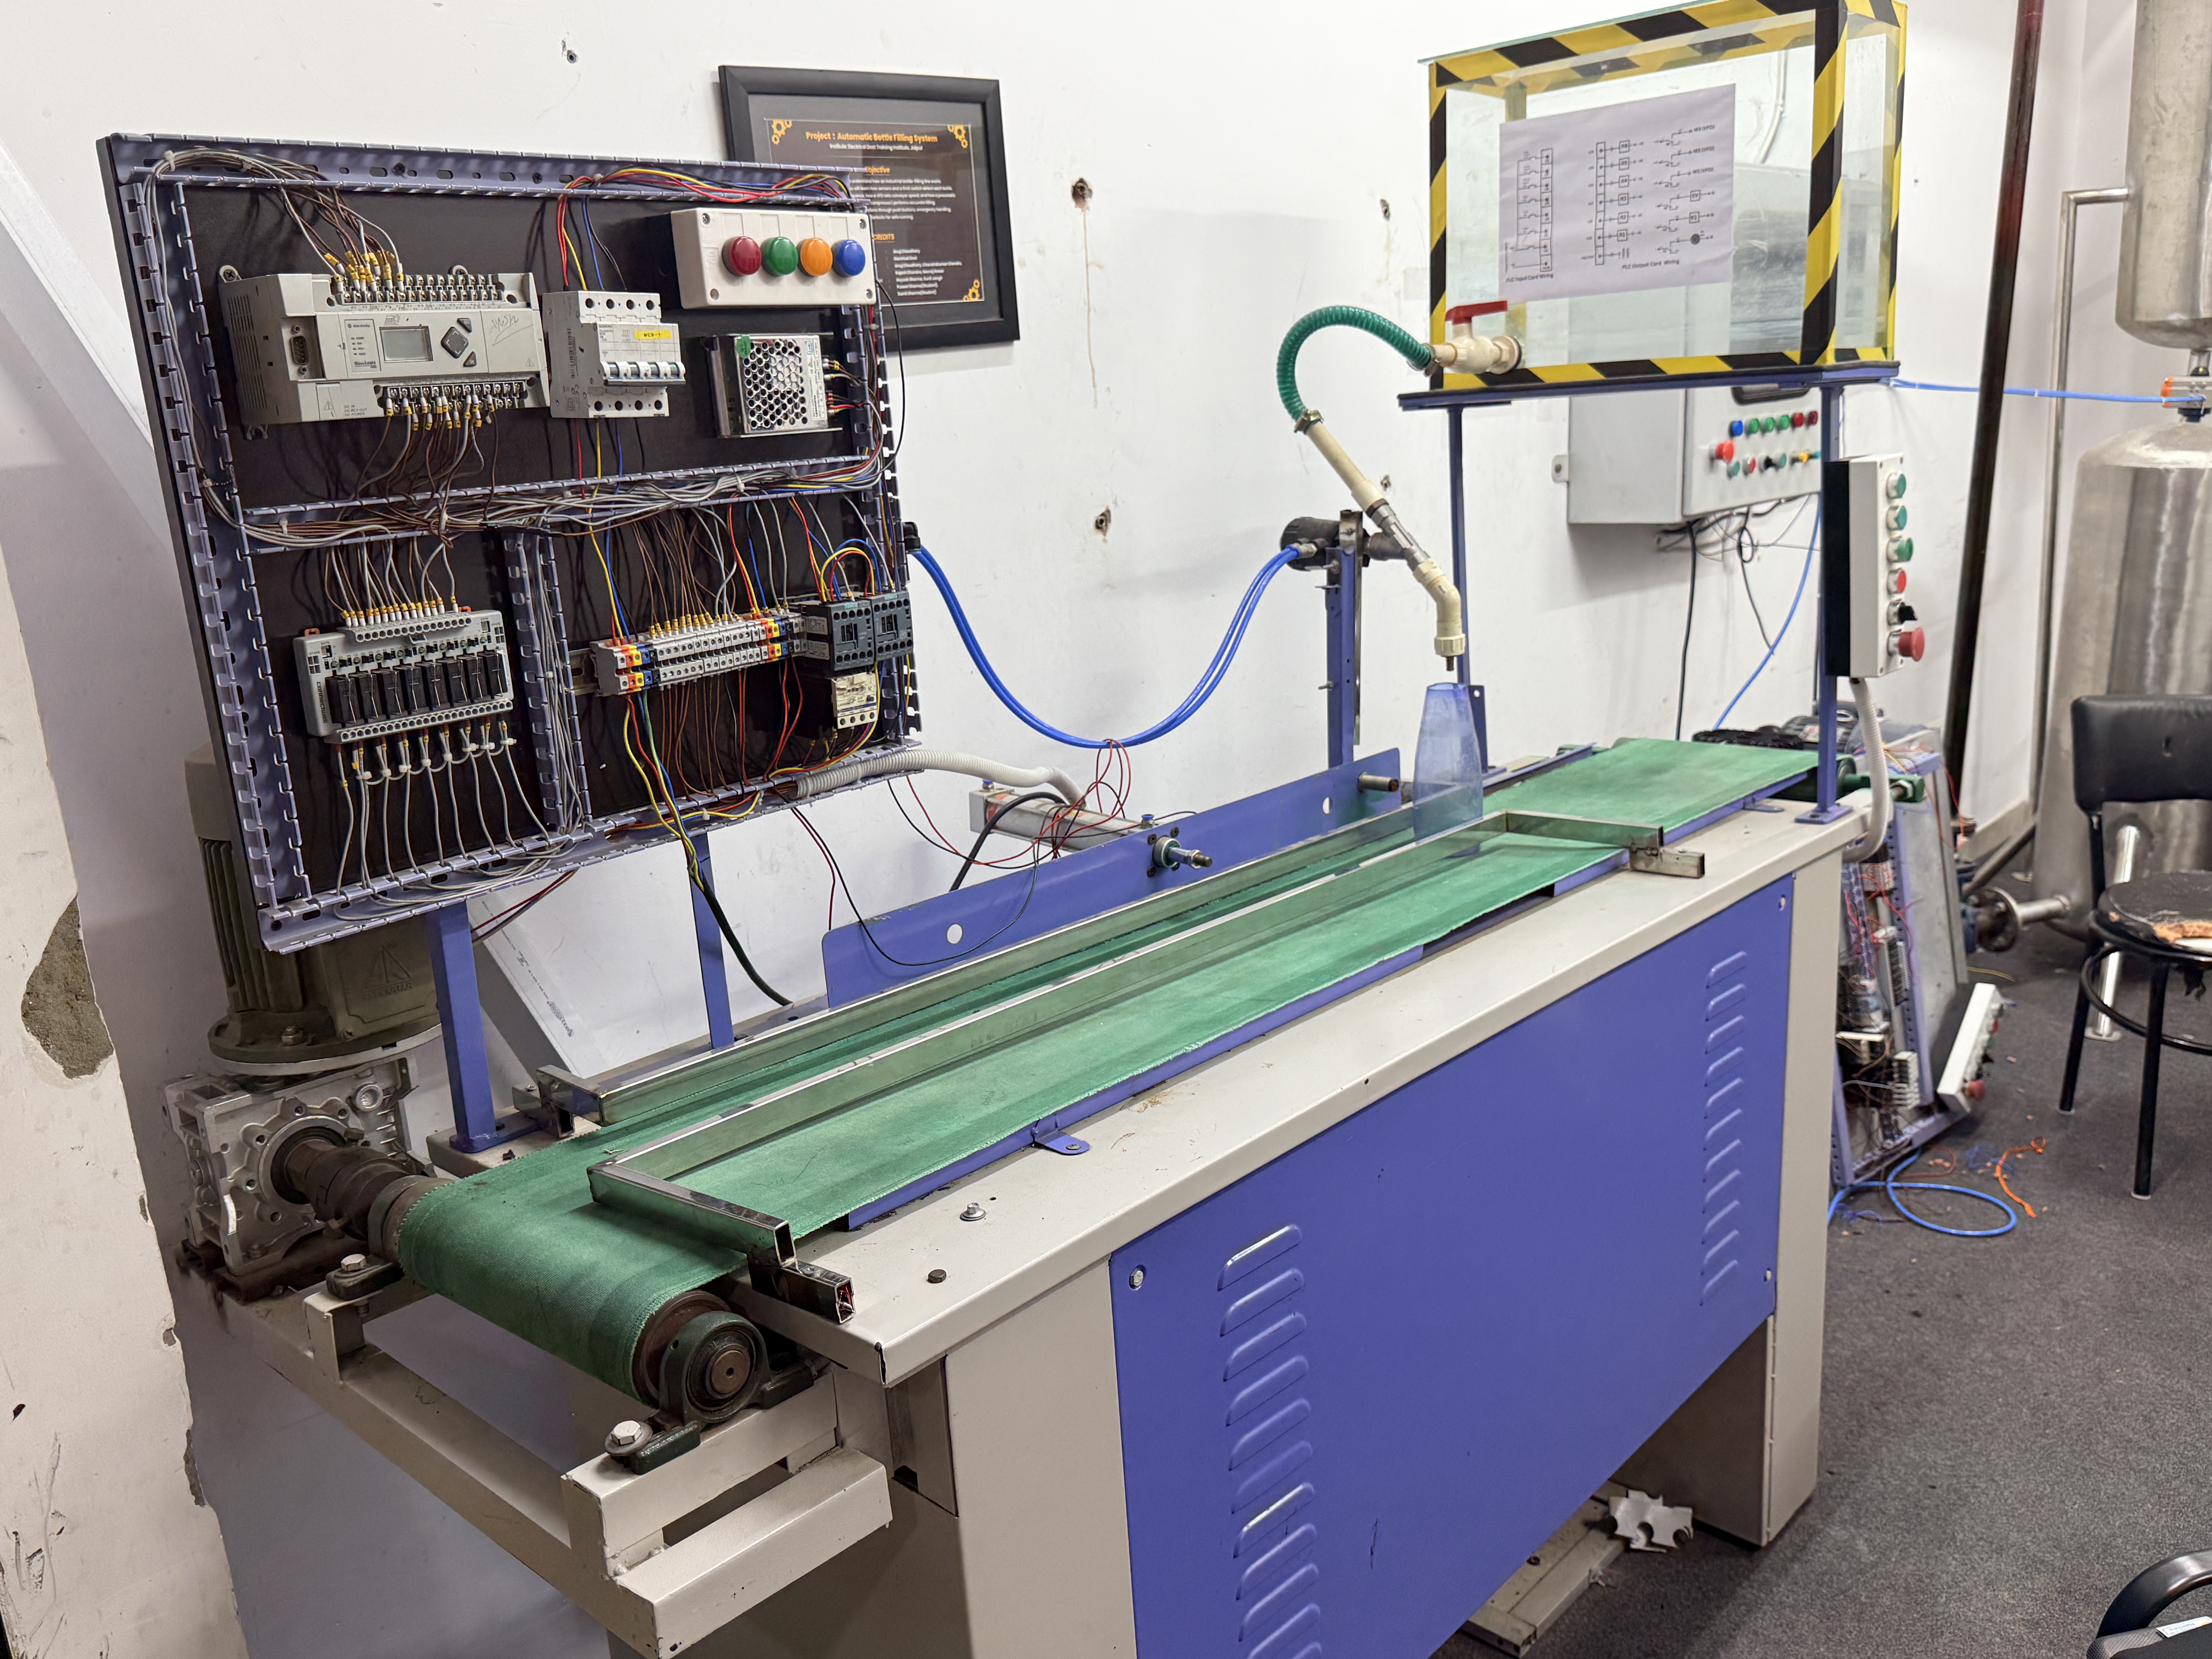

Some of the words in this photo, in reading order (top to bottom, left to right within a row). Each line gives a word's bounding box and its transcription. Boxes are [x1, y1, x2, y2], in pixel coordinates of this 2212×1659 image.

[806, 131, 831, 142] Project
[838, 132, 872, 141] Automatic
[873, 133, 893, 141] Bottle
[894, 134, 913, 144] Filling
[914, 134, 938, 144] System
